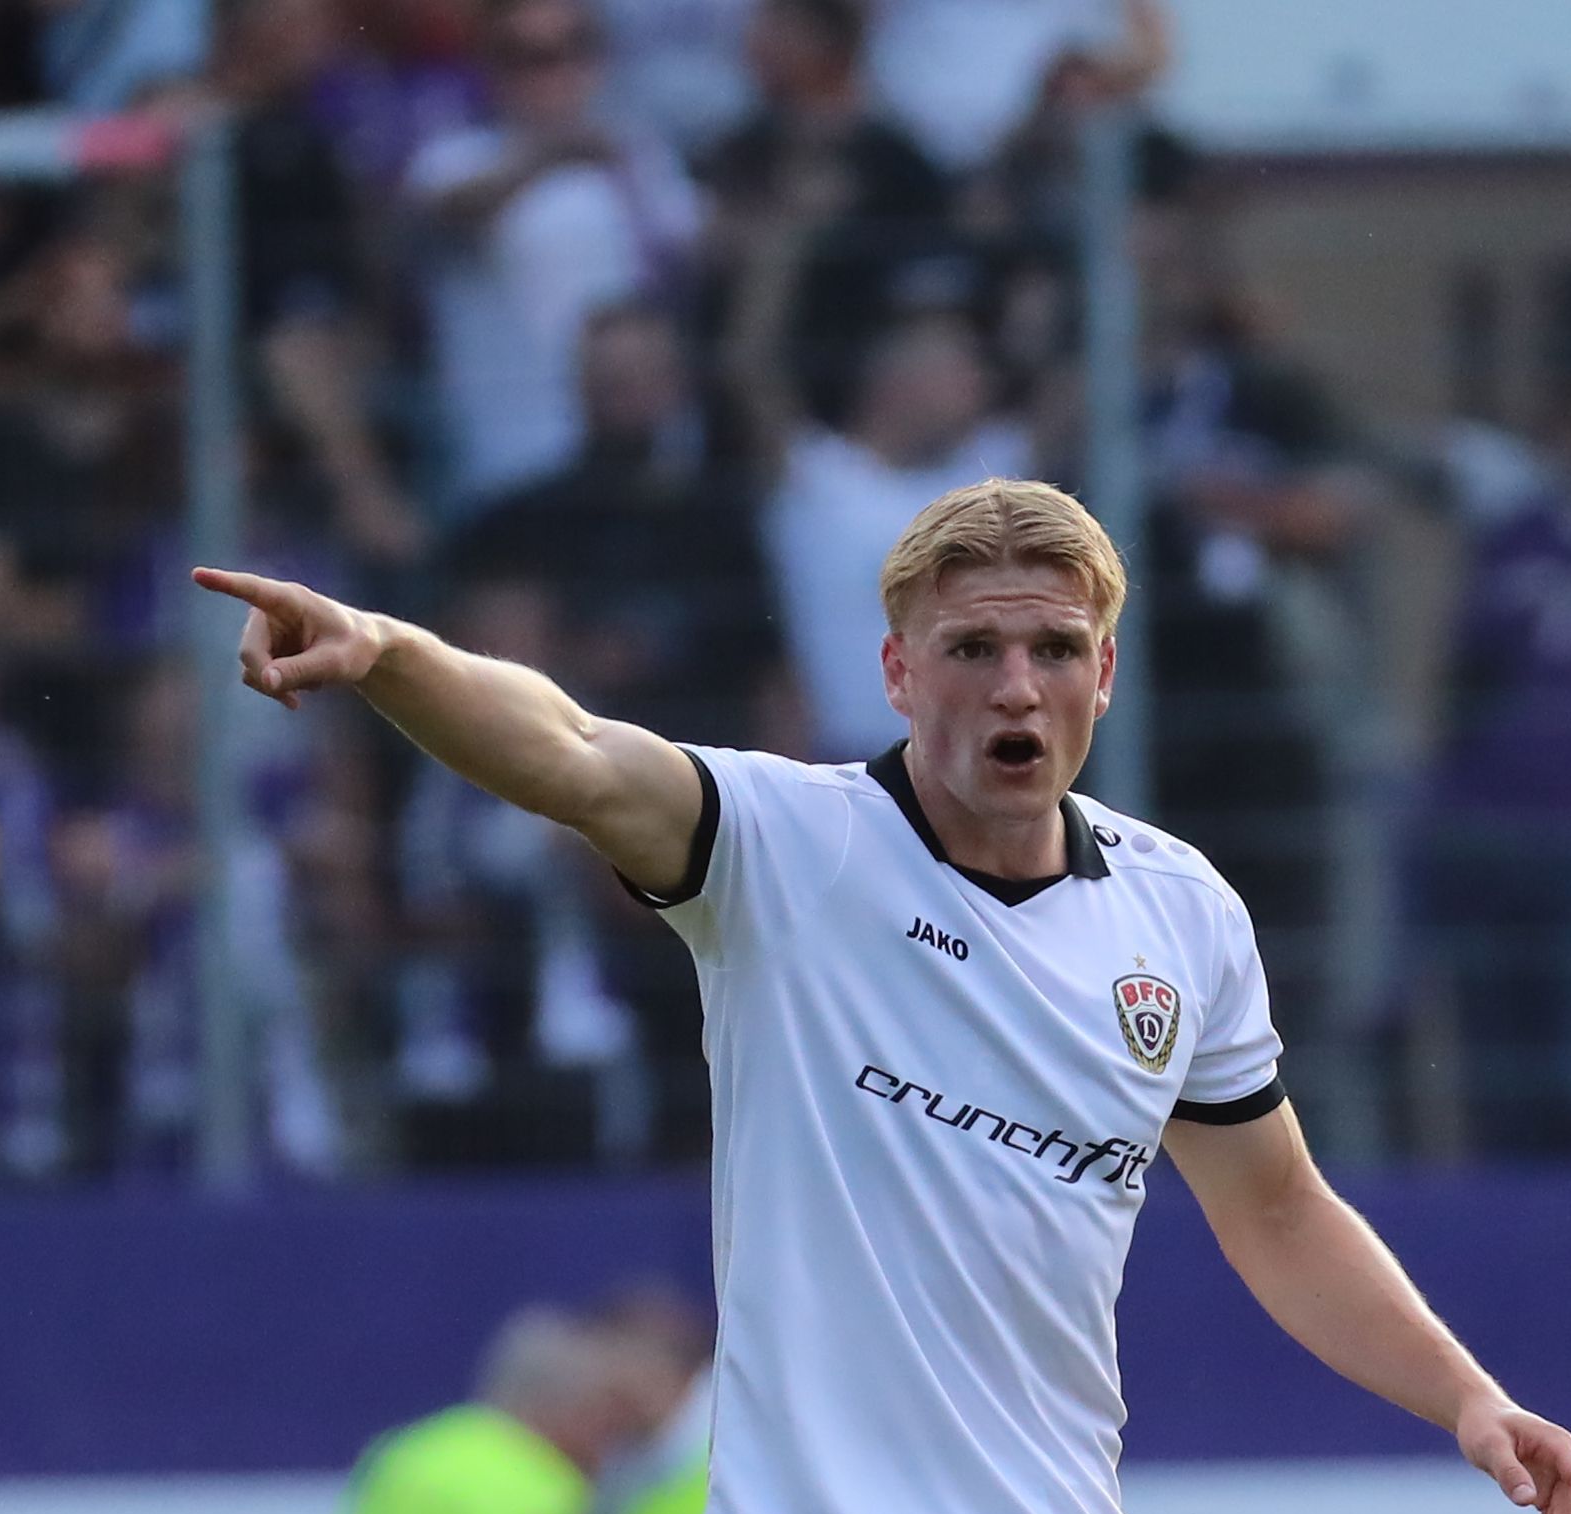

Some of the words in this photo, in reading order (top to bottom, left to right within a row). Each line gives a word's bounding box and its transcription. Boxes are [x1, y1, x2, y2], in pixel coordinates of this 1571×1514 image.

[906, 916, 969, 961] JAKO
[1120, 981, 1172, 1013] BFC
[1138, 1014, 1161, 1043] D
[855, 1064, 1148, 1190] crunchfit
